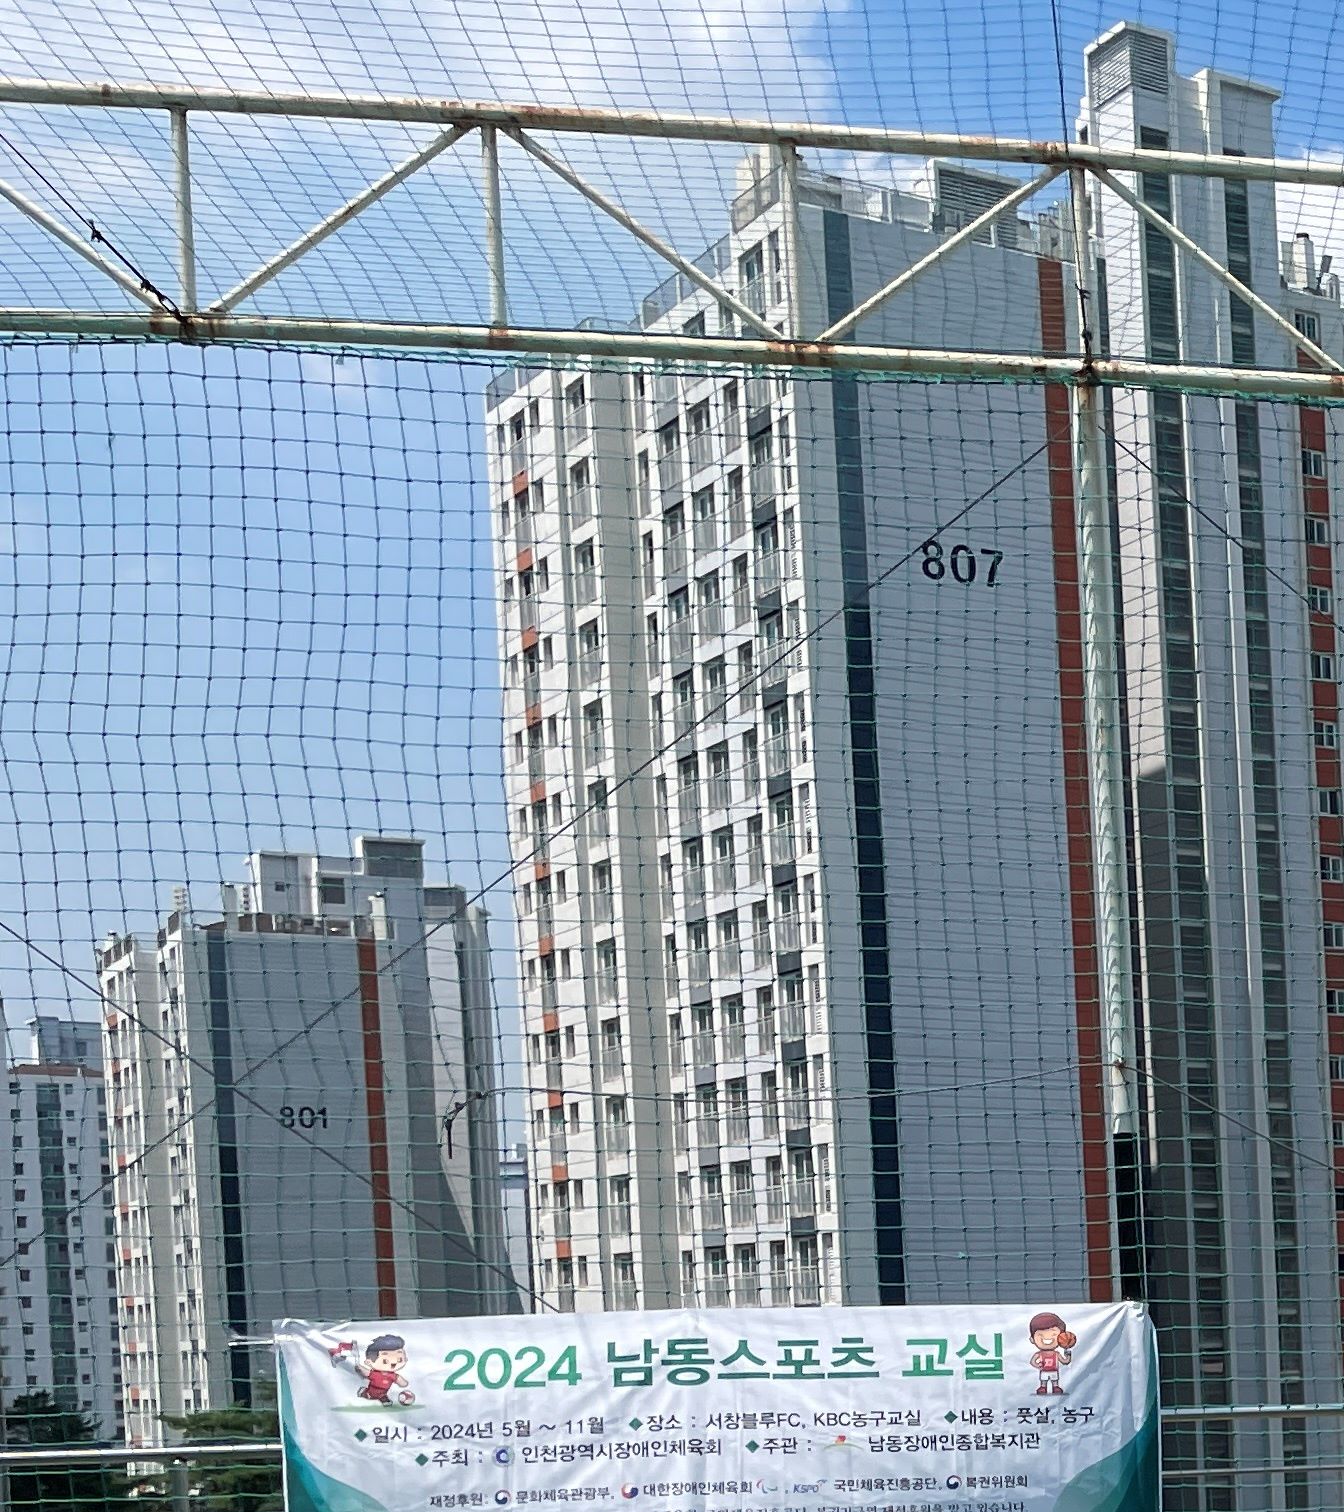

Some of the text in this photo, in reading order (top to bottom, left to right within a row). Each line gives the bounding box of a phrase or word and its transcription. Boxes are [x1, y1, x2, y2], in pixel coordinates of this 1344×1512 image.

[921, 539, 1003, 587] 807
[279, 1106, 328, 1129] 801
[443, 1332, 1005, 1392] 2024 남동스포츠 교실
[646, 1414, 682, 1432] 장소
[813, 1408, 921, 1427] KBC농구교실
[961, 1407, 994, 1426] 내용
[1062, 1406, 1096, 1423] 농구
[372, 1426, 408, 1444] 일시
[431, 1421, 493, 1441] 2024년
[502, 1418, 531, 1438] 5월
[566, 1416, 606, 1434] 11월
[432, 1448, 468, 1467] 주최
[522, 1438, 721, 1464] 인천광역시장애인체육회
[762, 1437, 798, 1456] 주관
[868, 1432, 1041, 1453] 남동장애인종합복지관
